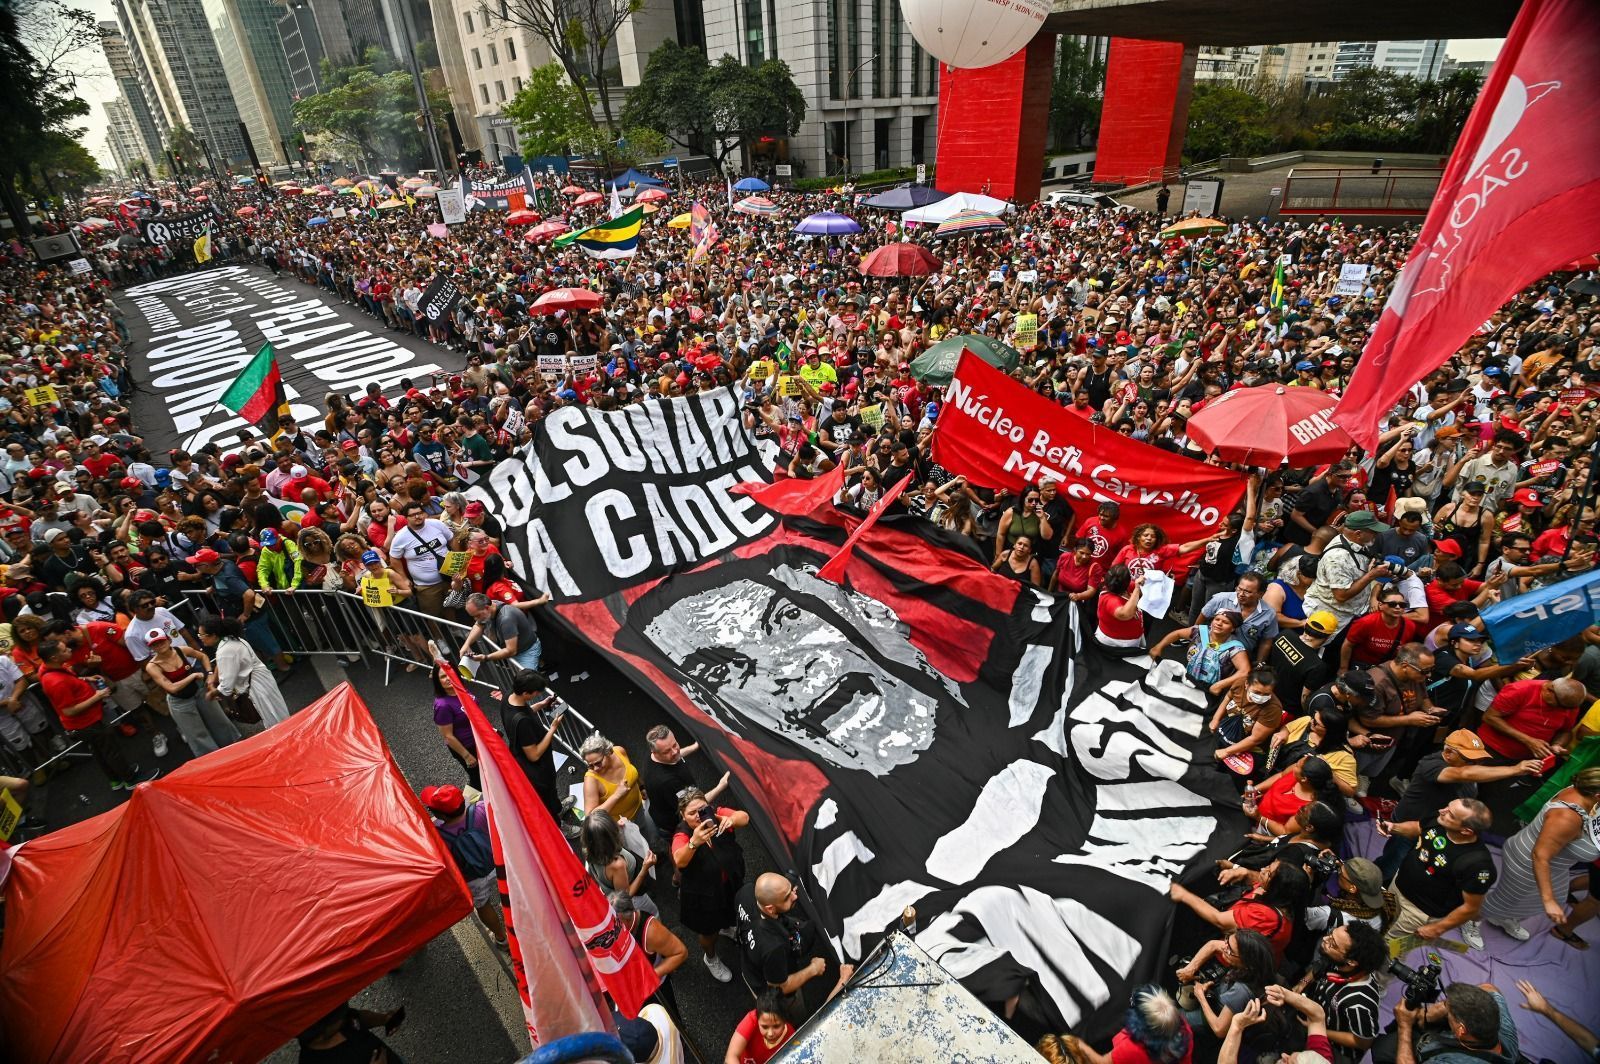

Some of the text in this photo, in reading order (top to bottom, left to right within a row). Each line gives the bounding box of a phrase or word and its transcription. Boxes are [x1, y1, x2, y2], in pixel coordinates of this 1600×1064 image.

[471, 176, 526, 191] SEM ANISTIA
[471, 185, 527, 198] PARA GOLPISTAS
[146, 318, 258, 388] POVO
[250, 298, 444, 402] PELA VIDA
[945, 377, 1219, 527] Núcleo Beth Carvalho
[1277, 639, 1299, 660] AHEAD
